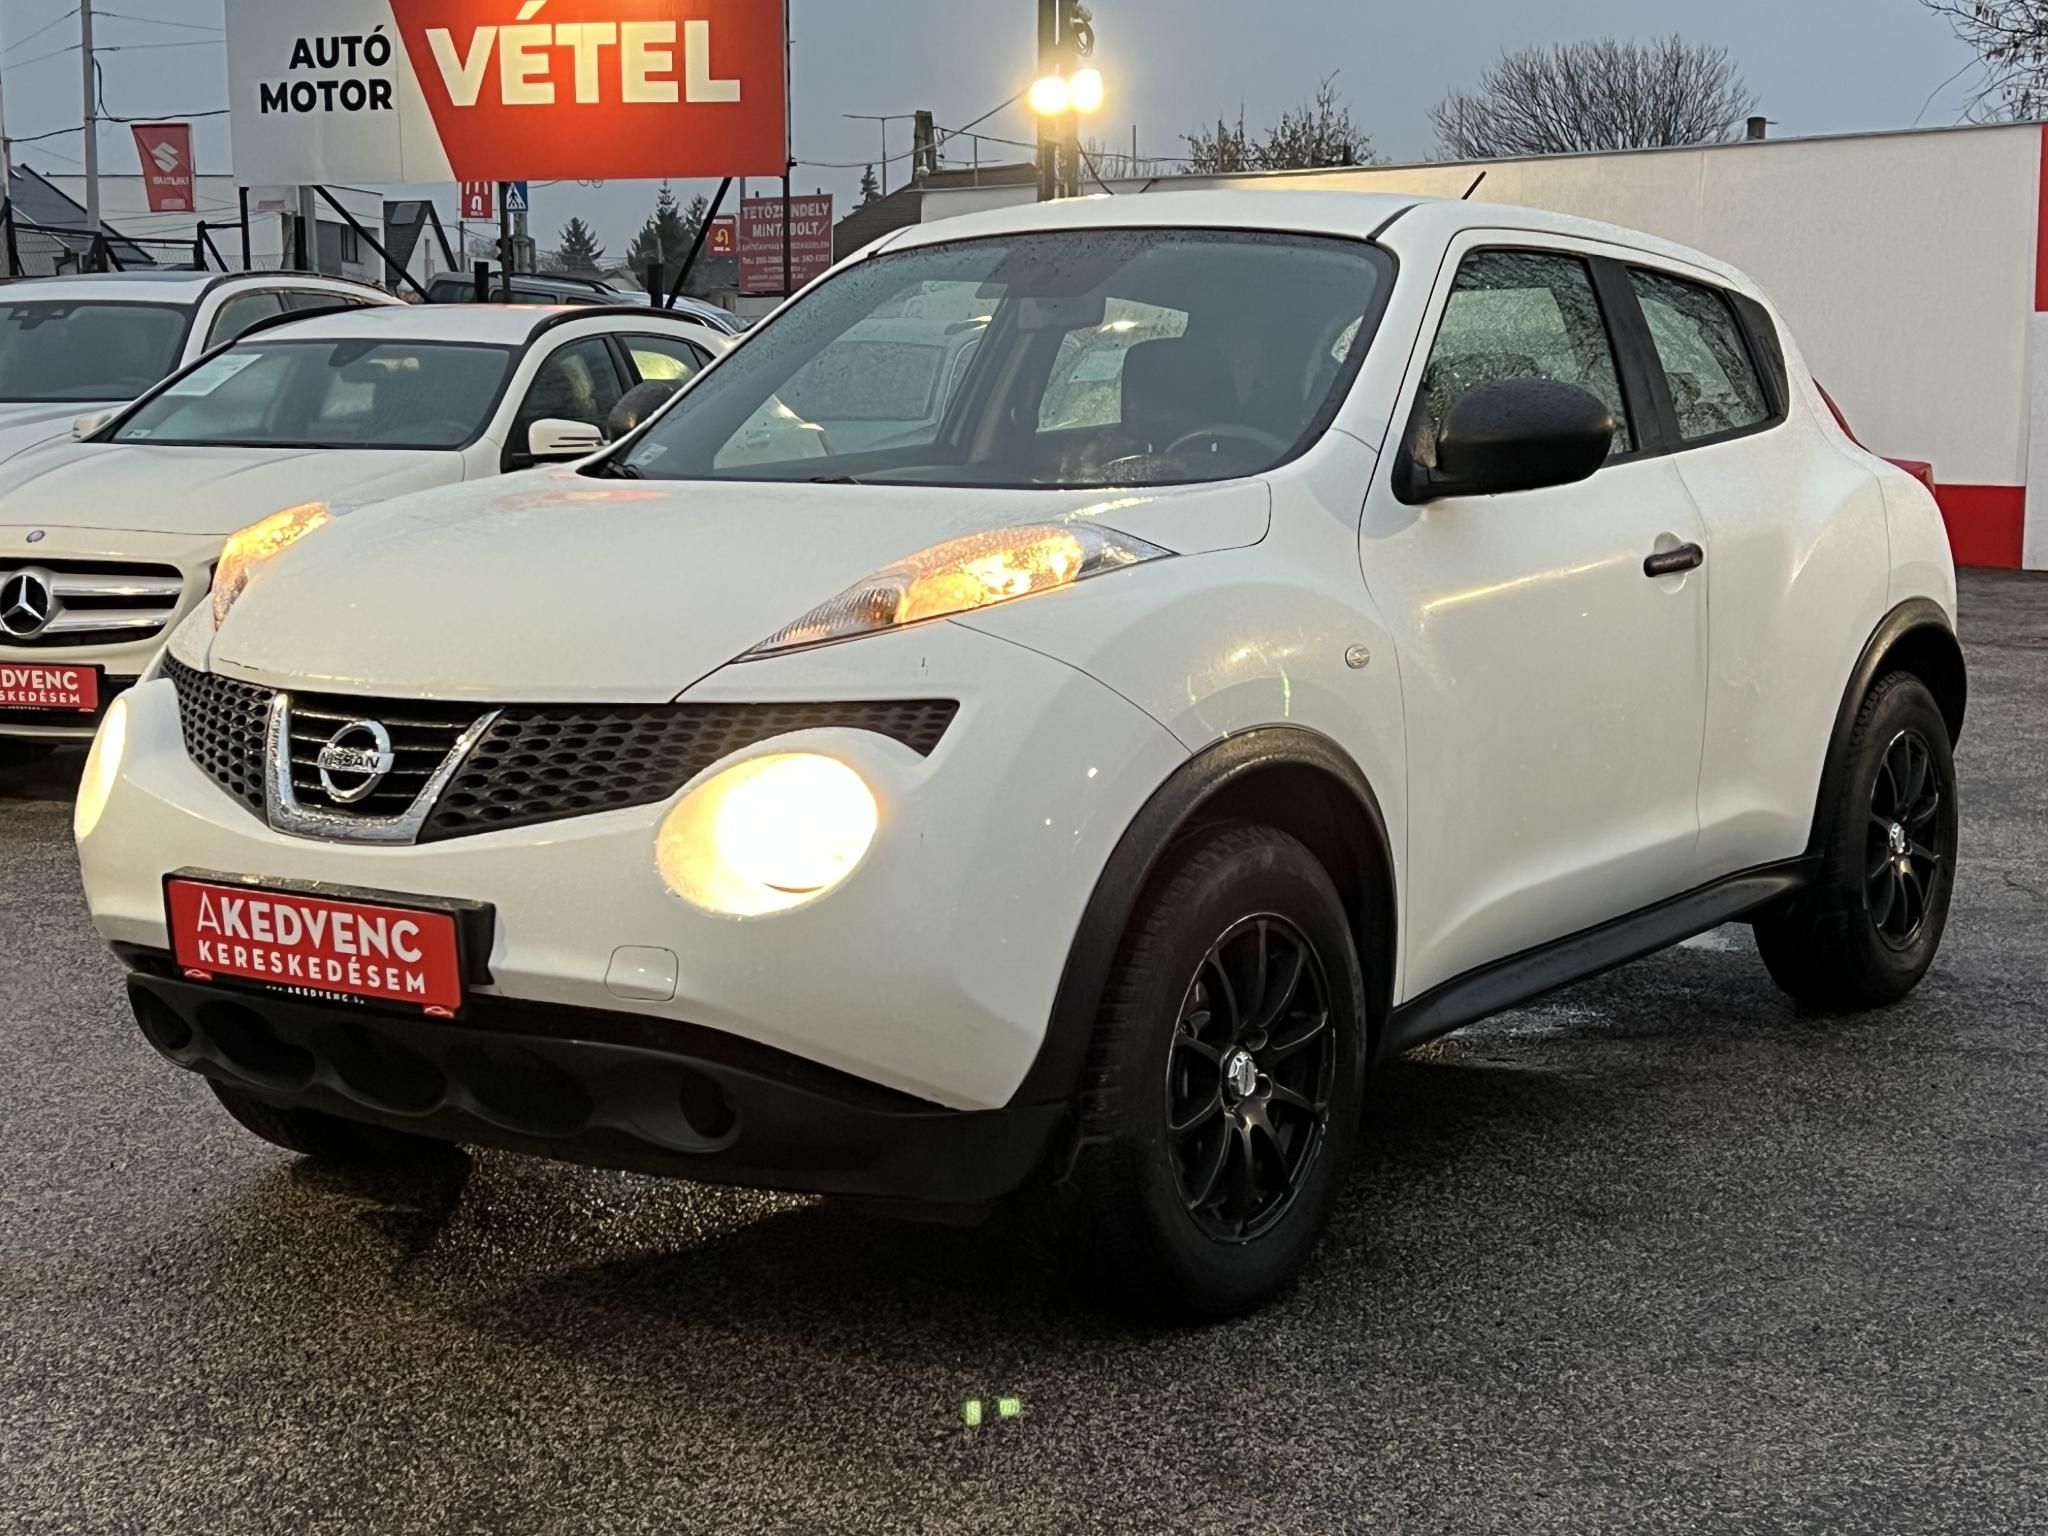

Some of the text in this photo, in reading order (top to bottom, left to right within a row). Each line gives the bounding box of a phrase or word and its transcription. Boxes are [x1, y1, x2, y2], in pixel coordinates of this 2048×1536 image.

[289, 25, 391, 69] AUTÓ
[425, 0, 740, 106] VÉTEL
[260, 79, 393, 113] MOTOR
[742, 202, 829, 220] TETŐZNDELY
[198, 940, 426, 994] KERESKEDÉSEM
